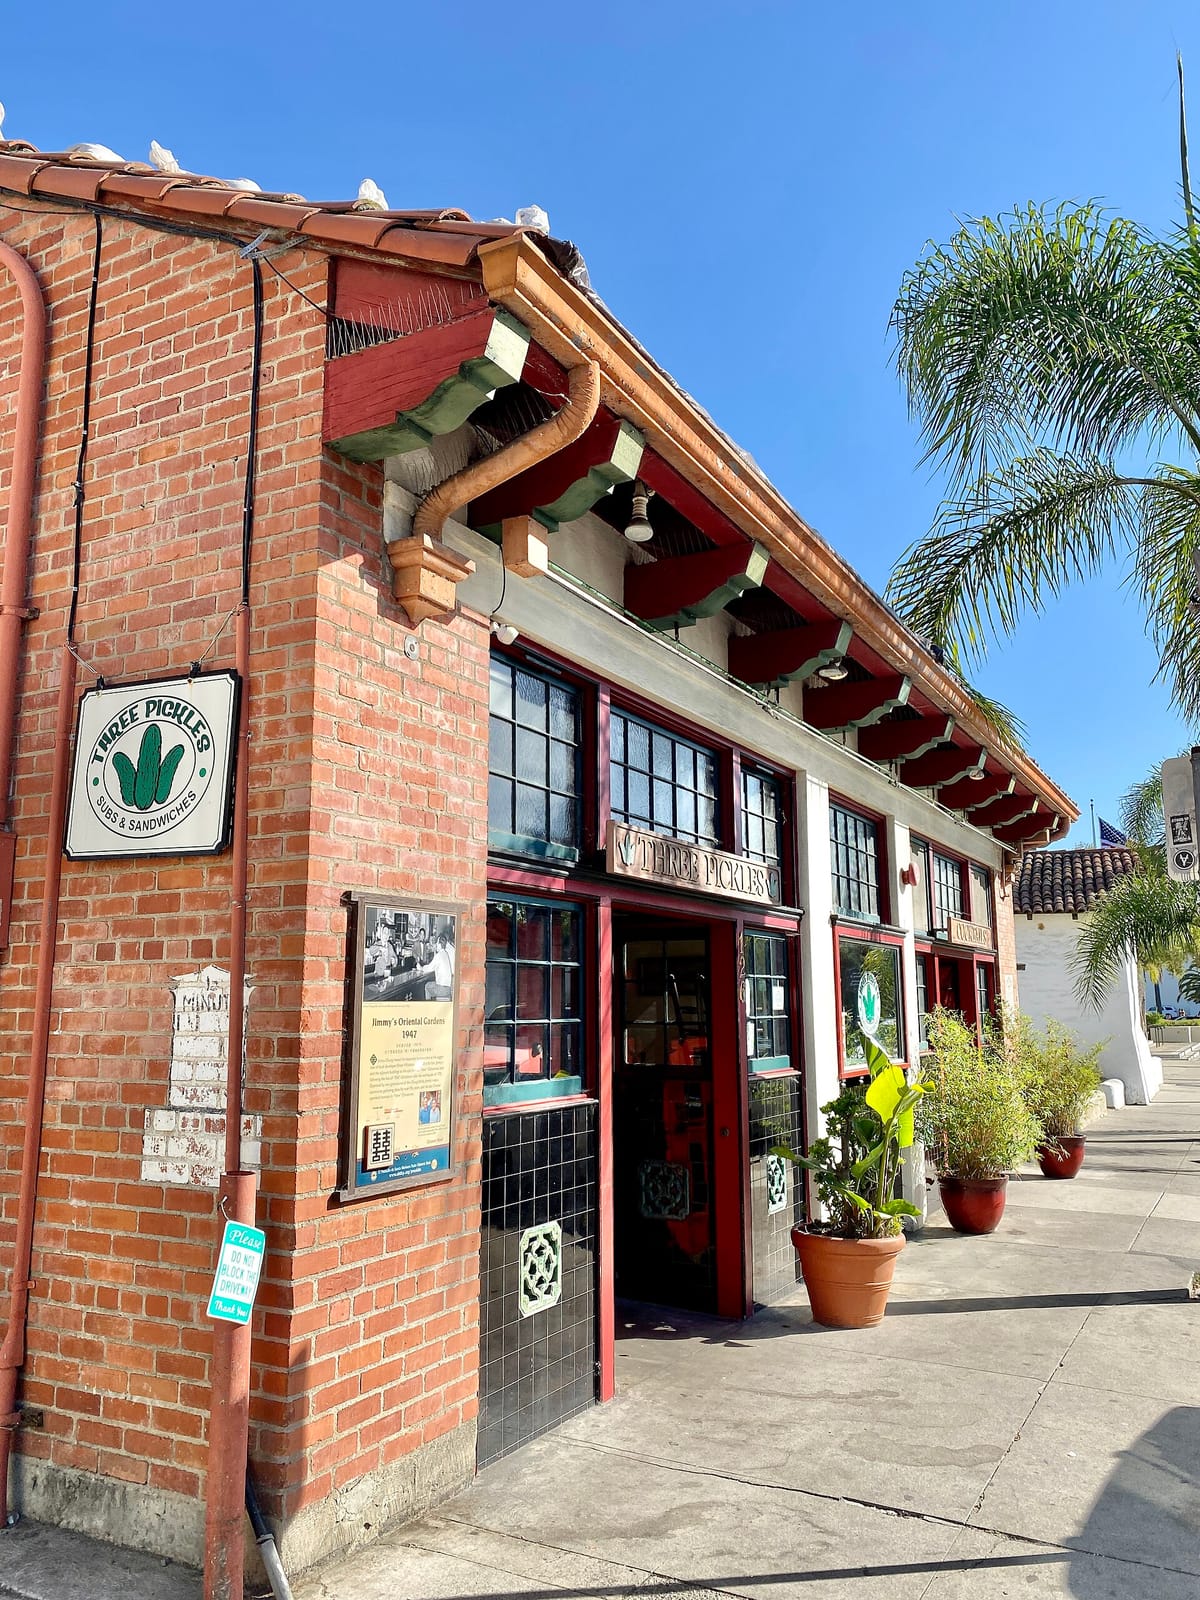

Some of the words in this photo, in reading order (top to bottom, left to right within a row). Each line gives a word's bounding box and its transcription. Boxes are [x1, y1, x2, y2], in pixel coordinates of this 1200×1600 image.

[91, 704, 139, 765] THREE
[145, 699, 211, 753] PICKLES
[97, 795, 119, 823] SUBS
[119, 817, 126, 829] &
[128, 790, 197, 832] SANDWICHES
[638, 838, 699, 882] THREE
[703, 854, 764, 896] PICKLES
[372, 1017, 397, 1028] Jimmy's
[398, 1017, 422, 1026] Oriental
[423, 1016, 445, 1025] Gardens
[402, 1030, 417, 1039] 1947
[230, 1230, 261, 1249] Please
[231, 1250, 241, 1263] DO
[243, 1254, 255, 1266] NOT
[221, 1263, 244, 1280] BLOCK
[247, 1270, 257, 1284] THE
[220, 1280, 251, 1296] DRIVEWAY
[215, 1300, 236, 1313] Thank
